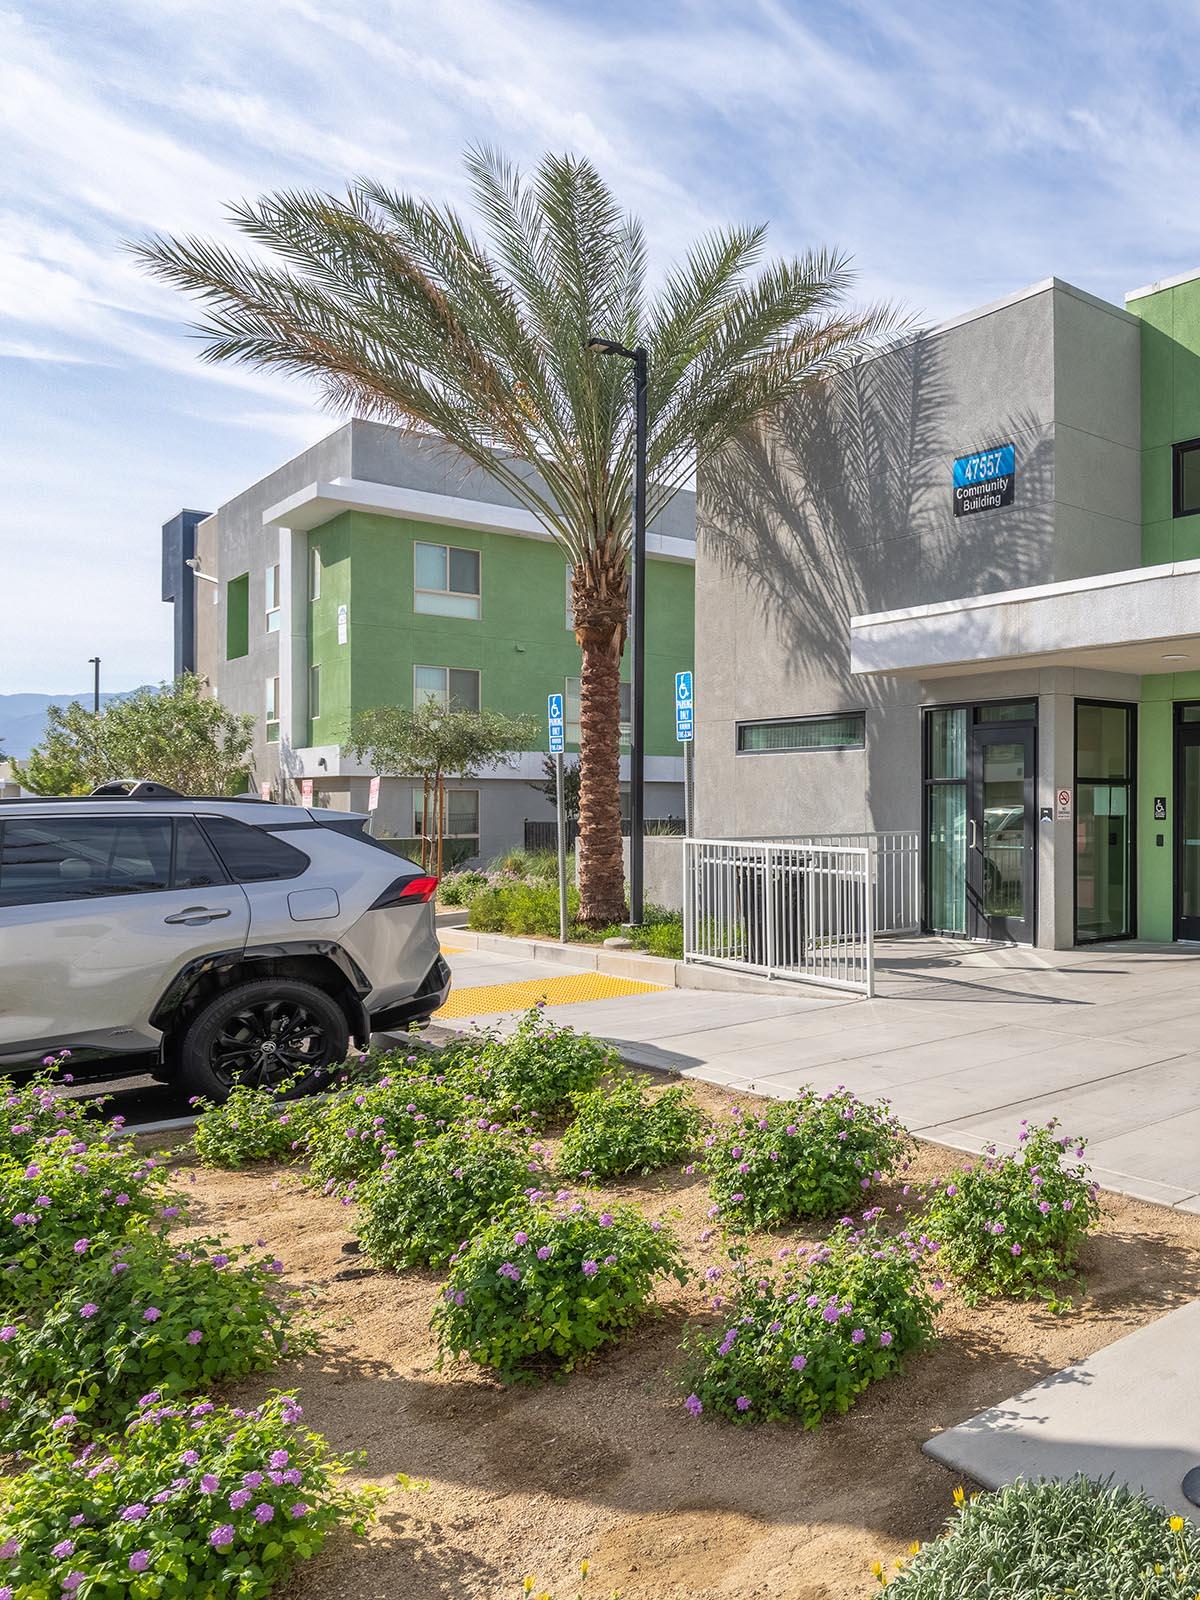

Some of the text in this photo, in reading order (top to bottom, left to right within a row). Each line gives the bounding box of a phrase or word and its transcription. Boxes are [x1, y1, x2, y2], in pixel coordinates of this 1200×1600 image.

[965, 452, 1002, 481] 47557
[956, 477, 1009, 500] Community
[963, 494, 1001, 511] Building
